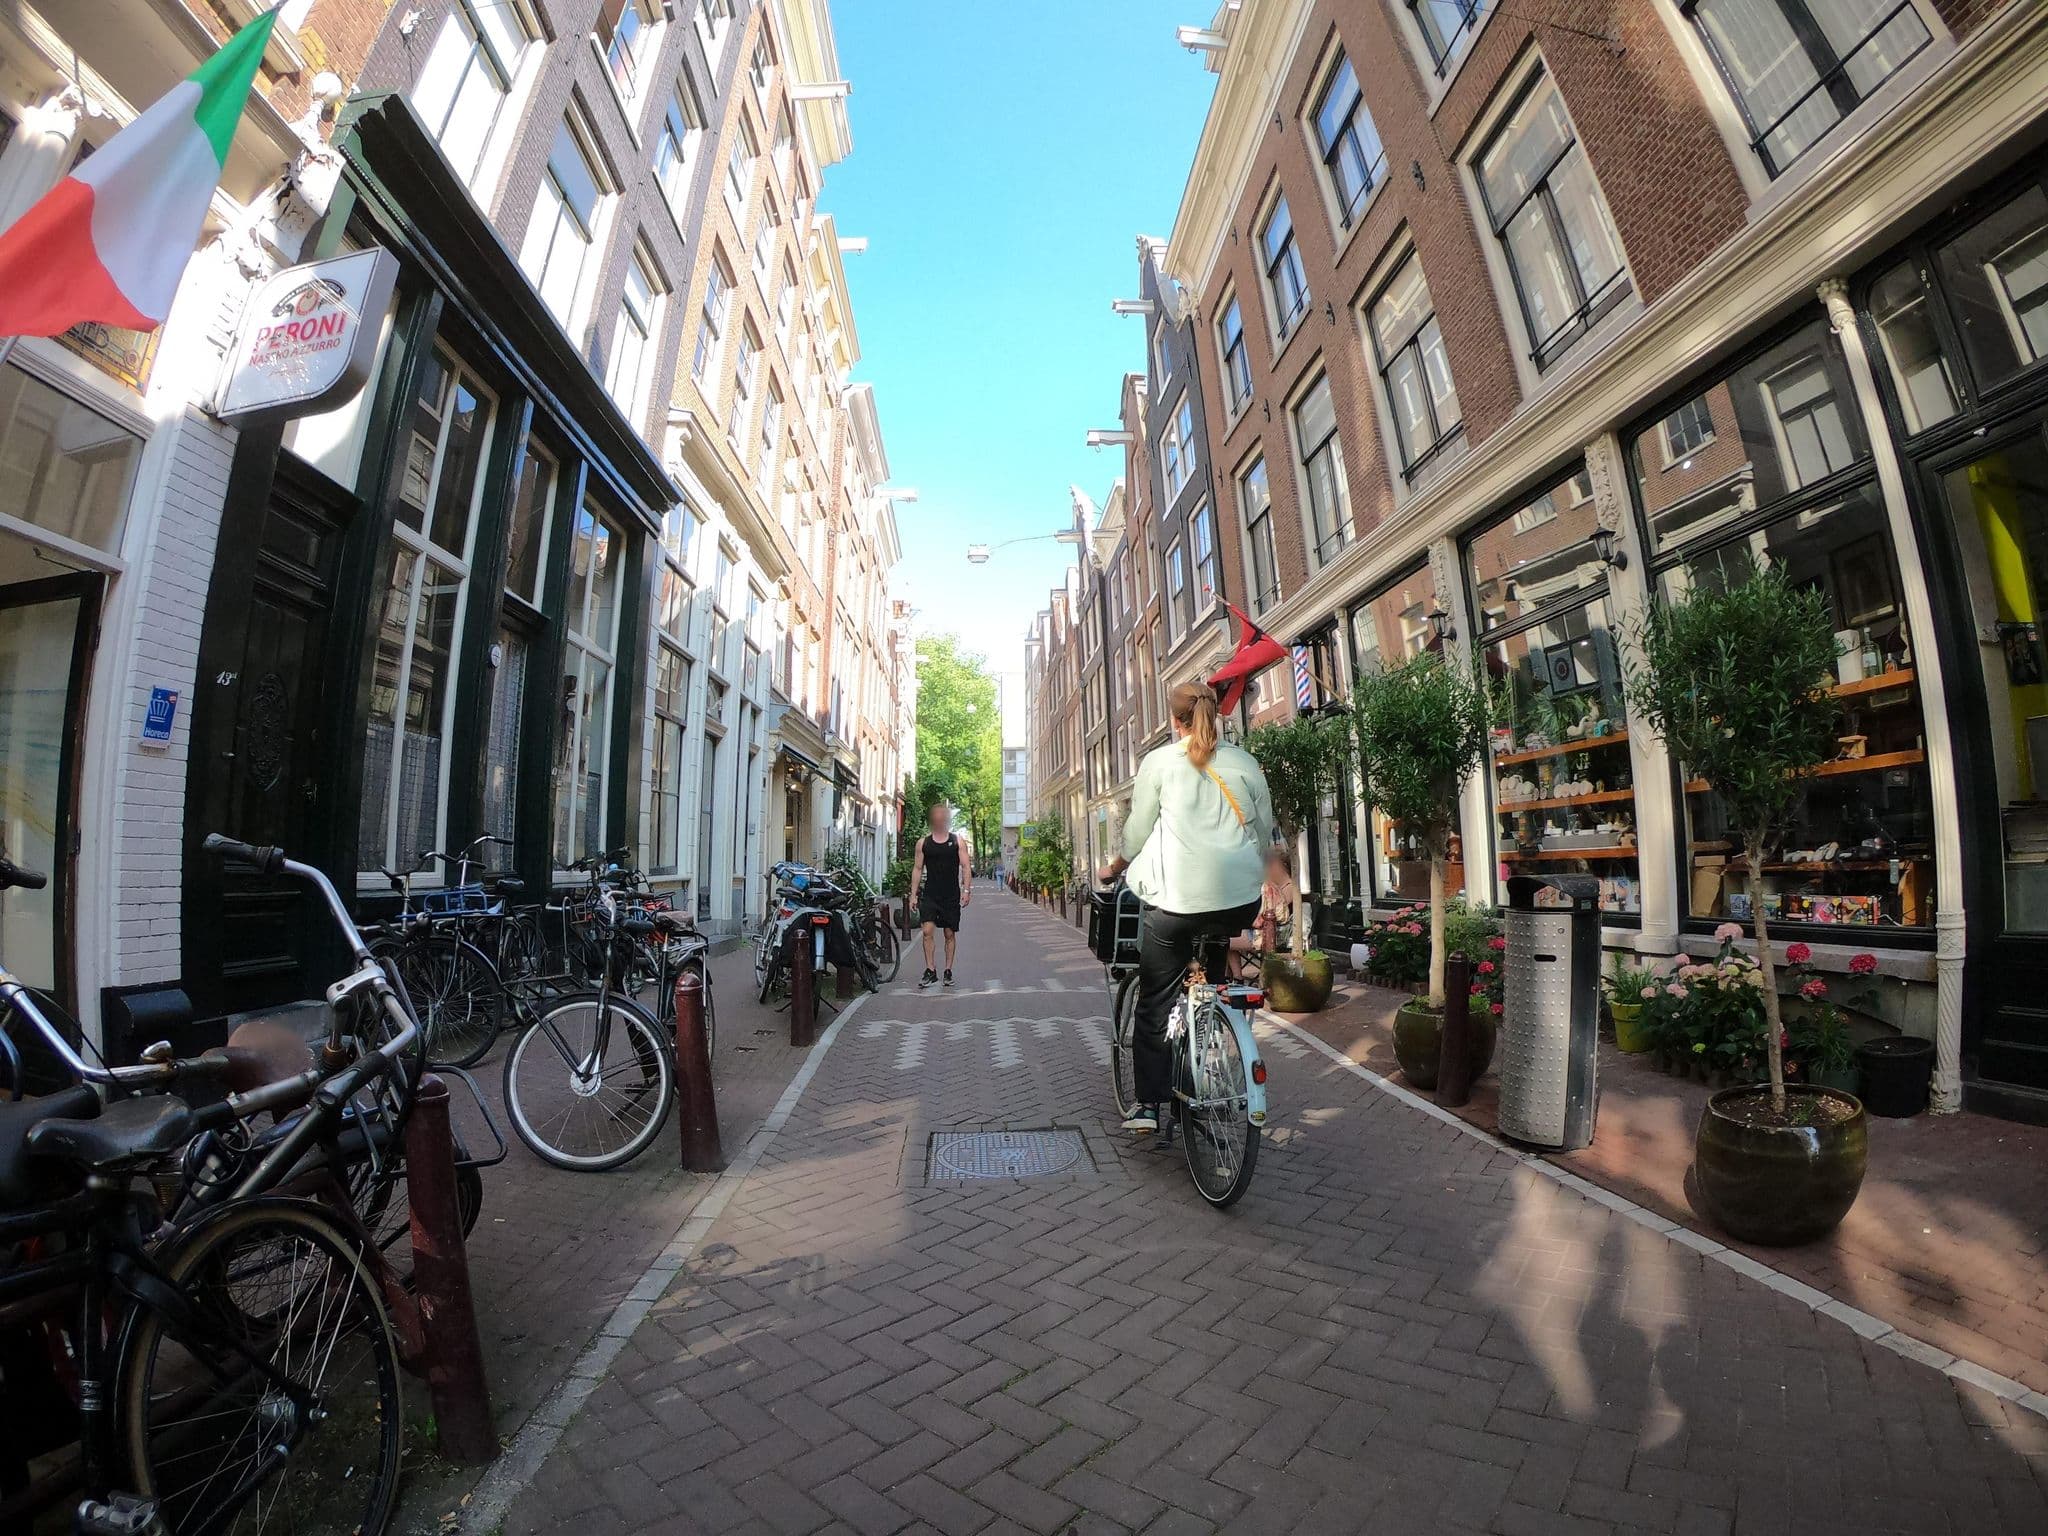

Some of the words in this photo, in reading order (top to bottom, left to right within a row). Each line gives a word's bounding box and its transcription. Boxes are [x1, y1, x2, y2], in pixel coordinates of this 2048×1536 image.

[253, 312, 347, 352] PERONI
[291, 337, 341, 358] AZZURRO
[144, 727, 170, 739] Horeca
